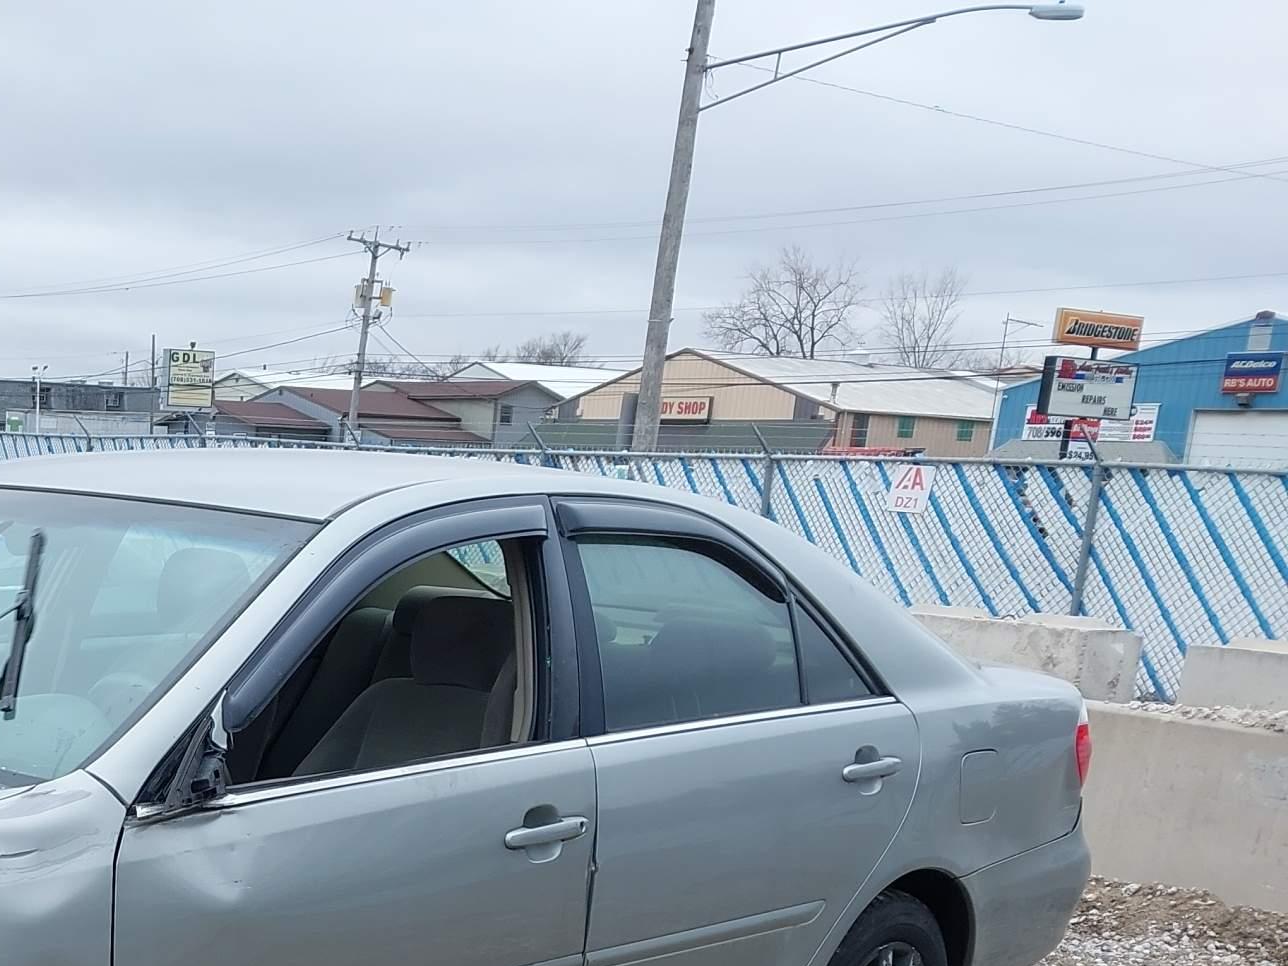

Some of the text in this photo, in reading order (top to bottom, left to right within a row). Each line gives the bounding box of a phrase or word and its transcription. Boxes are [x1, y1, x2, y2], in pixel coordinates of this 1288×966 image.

[1065, 318, 1139, 342] BRIDGESTONE
[171, 351, 200, 364] GDL
[1056, 383, 1085, 393] EMISSION
[1223, 377, 1274, 388] RB'S AUTO
[1081, 394, 1107, 405] REPAIRS
[678, 401, 706, 415] SHOP
[1102, 407, 1118, 417] HERE
